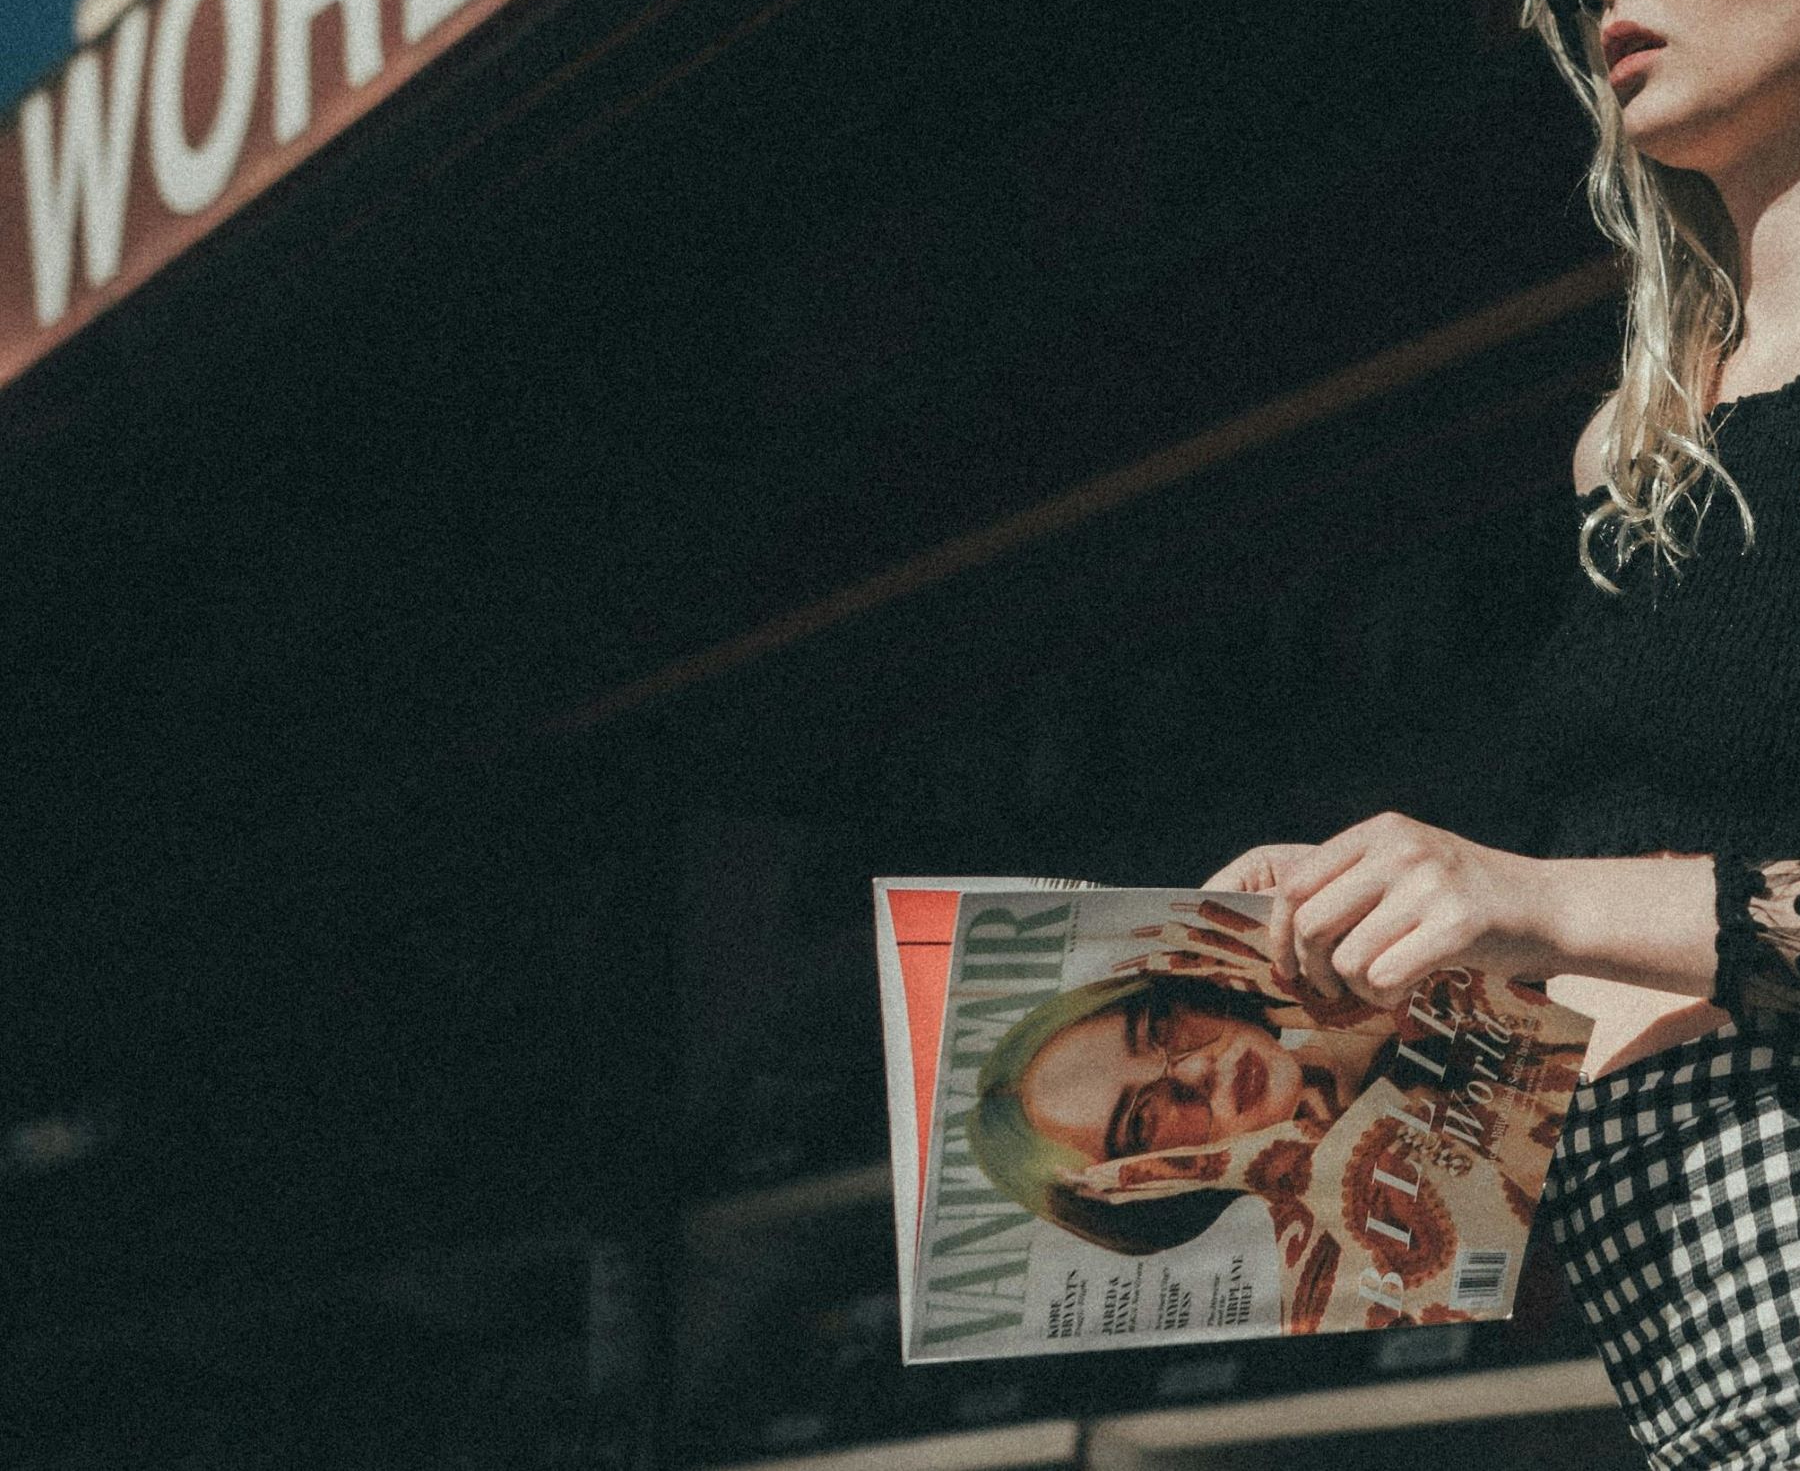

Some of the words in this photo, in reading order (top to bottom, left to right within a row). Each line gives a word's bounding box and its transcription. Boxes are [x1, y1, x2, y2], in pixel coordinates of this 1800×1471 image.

[1440, 1012, 1514, 1148] World
[1060, 1269, 1077, 1339] BRYANT'S
[1101, 1289, 1118, 1336] JARED
[1115, 1279, 1133, 1335] IVANKA
[1164, 1282, 1182, 1331] MAYOR
[1177, 1290, 1192, 1330] MESS
[1225, 1253, 1244, 1326] AIRPLANE
[1238, 1281, 1254, 1325] THIEF
[1047, 1300, 1061, 1340] KOBE
